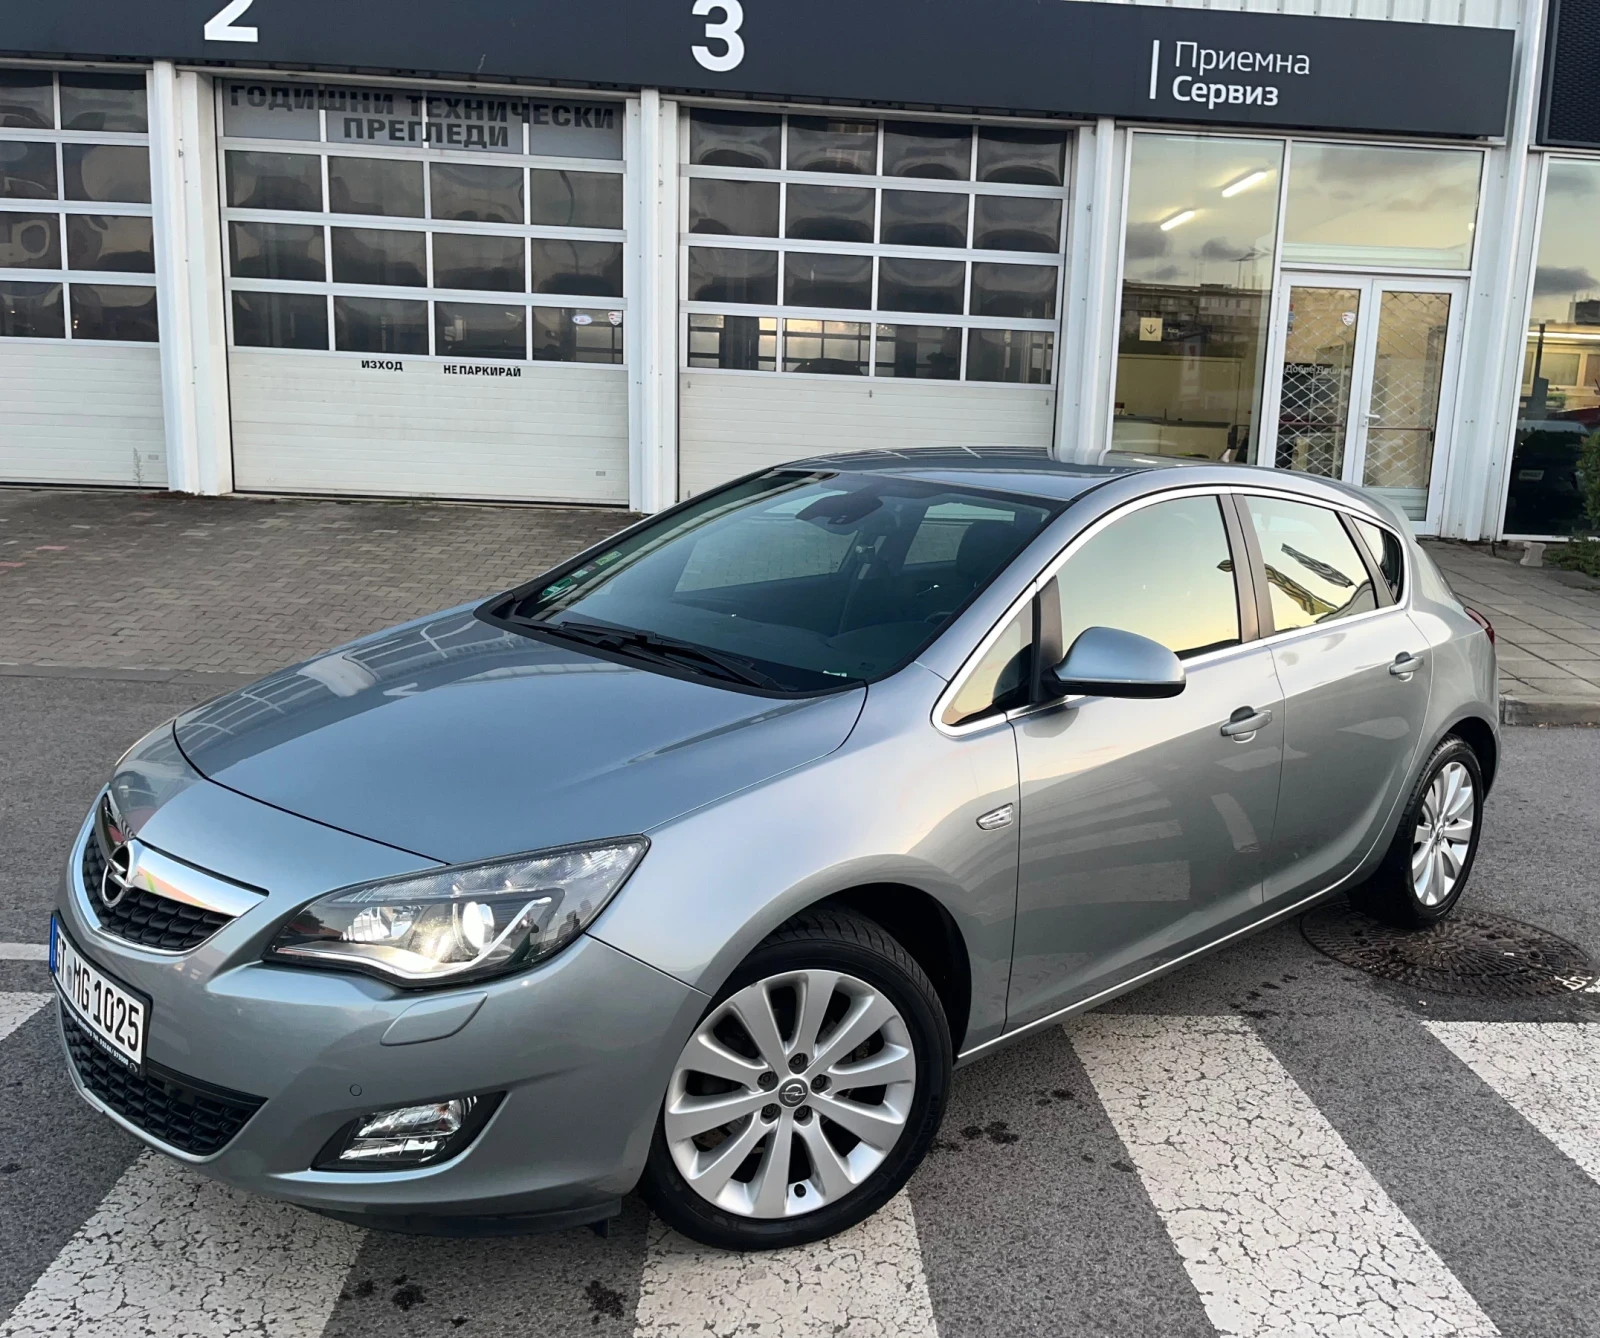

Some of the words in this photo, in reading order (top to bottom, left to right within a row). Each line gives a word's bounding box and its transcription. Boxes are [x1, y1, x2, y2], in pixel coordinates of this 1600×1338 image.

[204, 0, 258, 42] 2
[691, 0, 745, 72] 3
[1176, 41, 1310, 76] Приемна
[230, 85, 394, 115] ГОДИШНИ
[405, 95, 614, 129] ТЕХНИЧЕСКИ
[1172, 75, 1279, 110] Сервиз
[343, 117, 509, 149] ПРЕГЛЕДИ
[361, 360, 404, 372] ИЗХОД
[73, 956, 91, 1014] MG
[93, 979, 140, 1052] 1025
